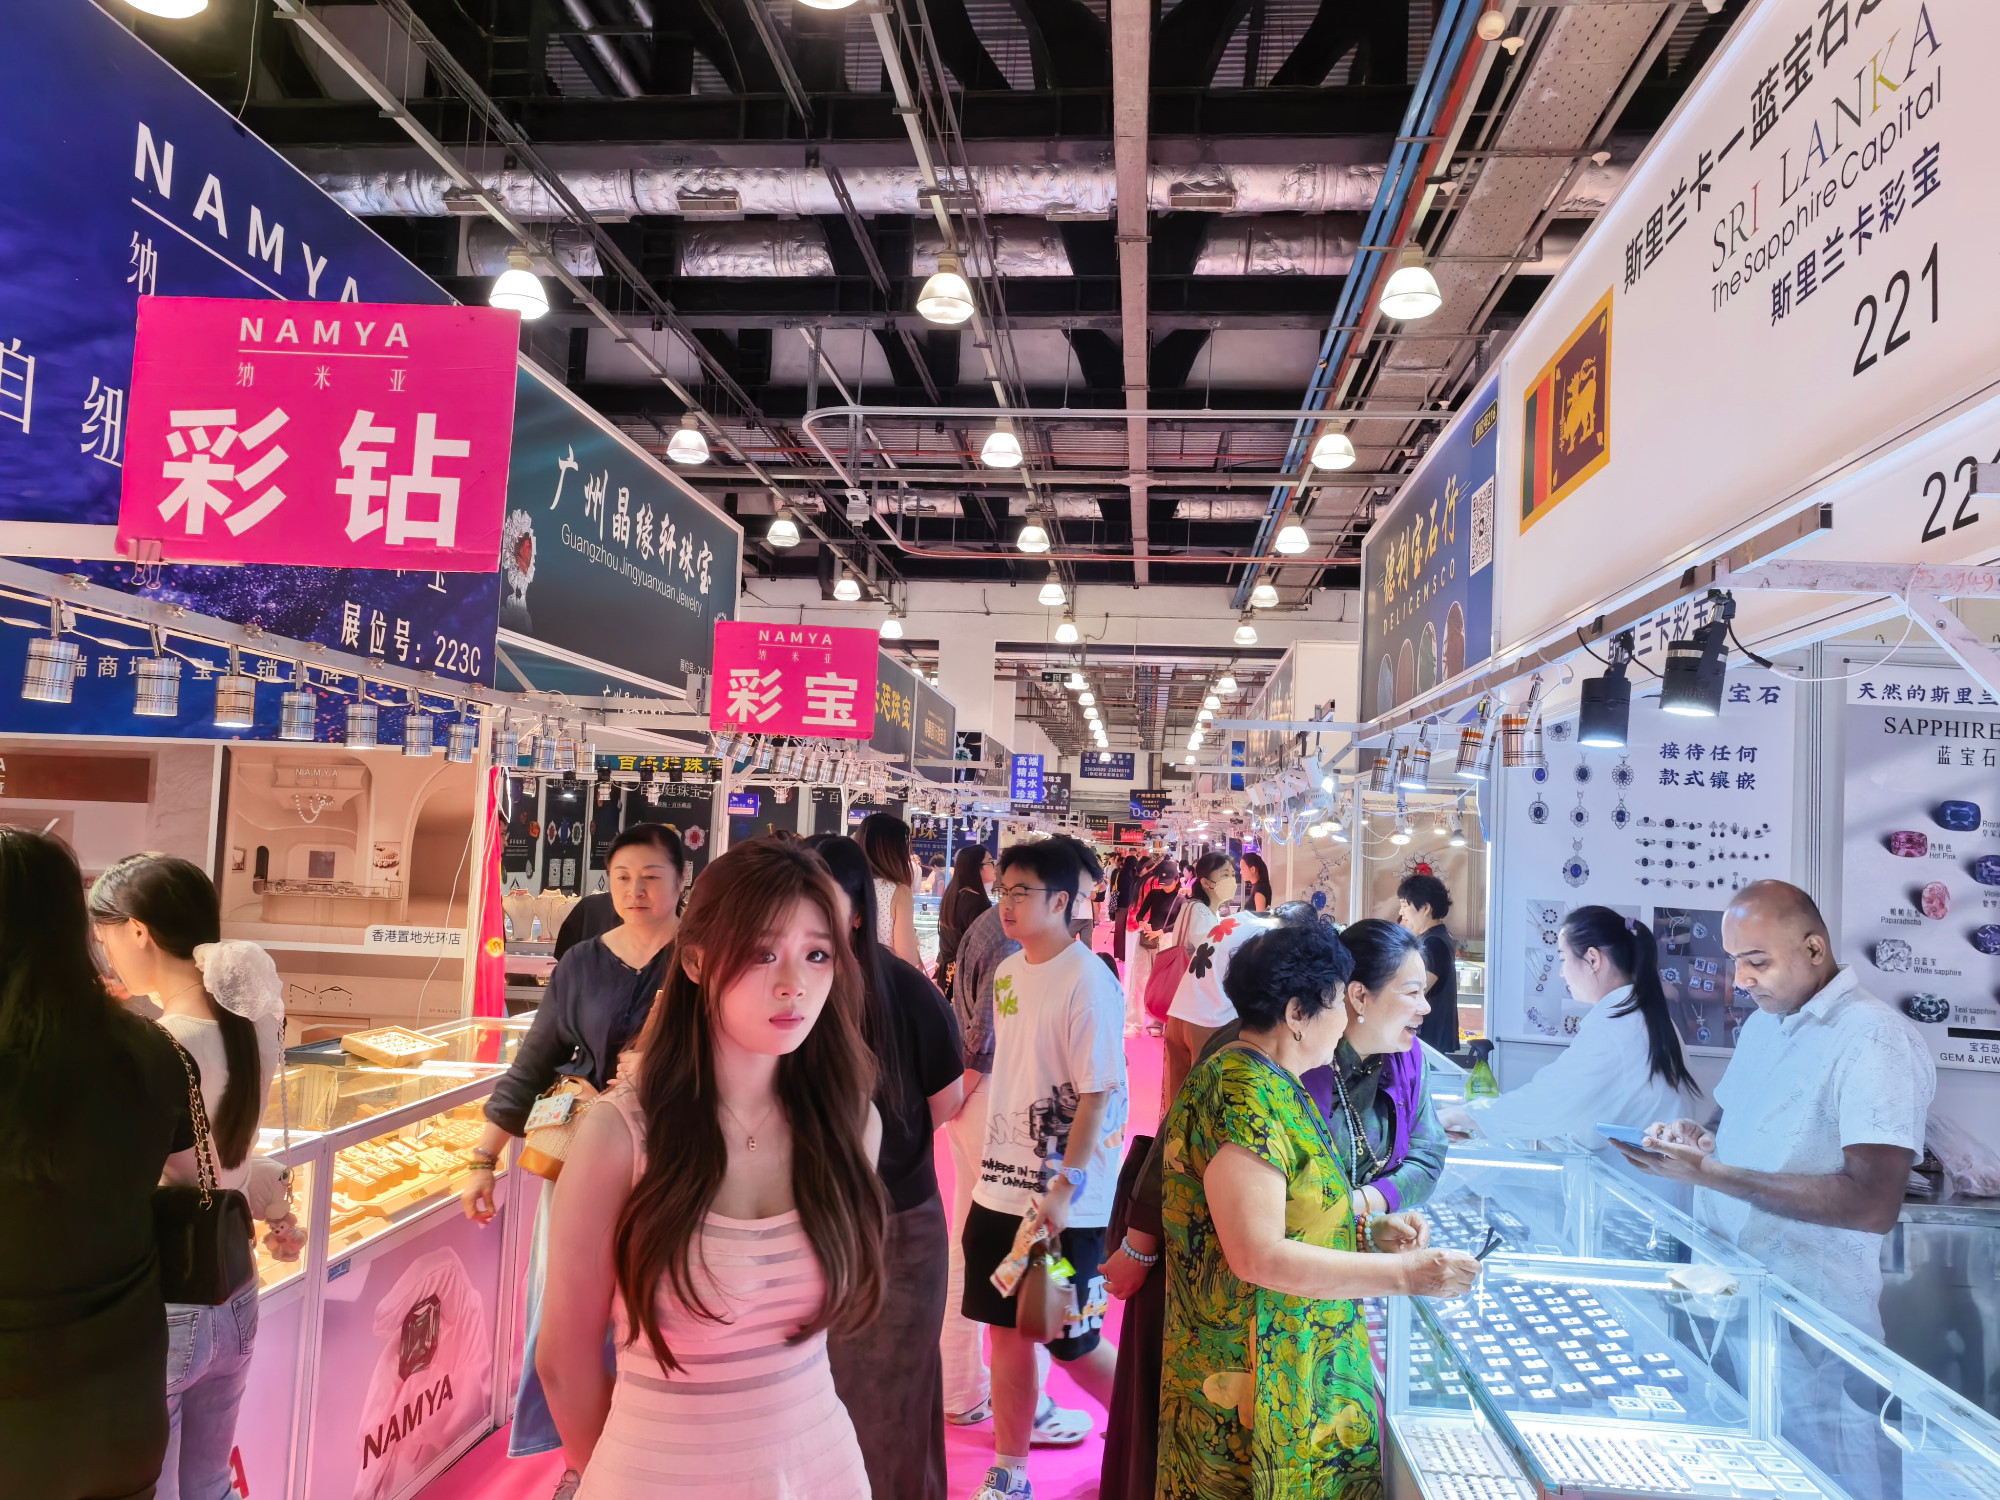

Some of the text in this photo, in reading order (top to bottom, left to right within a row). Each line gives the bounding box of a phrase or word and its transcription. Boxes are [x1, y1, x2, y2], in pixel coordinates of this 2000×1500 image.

[1712, 2, 1942, 273] SRI LANKA
[1771, 142, 1941, 327] 斯里兰卡彩宝
[1853, 242, 1938, 377] 221
[239, 317, 409, 347] NAMYA
[236, 362, 407, 392] 纳米亚
[157, 407, 470, 547] 彩钻
[1922, 449, 2000, 544] 22
[561, 523, 703, 617] Guangzhou Jingyuanxuan Jewelry
[759, 630, 832, 645] NAMYA
[727, 669, 858, 727] 彩宝
[1857, 682, 1999, 706] 天然的斯里兰
[1884, 717, 2000, 740] SAPPHIRE
[1017, 756, 1039, 767] 高端
[1659, 742, 1758, 764] 接待任何
[1937, 745, 1997, 768] 蓝宝石
[1016, 767, 1038, 778] 精品
[1016, 778, 1038, 789] 海水
[1658, 768, 1756, 790] 款式镶嵌
[1015, 789, 1038, 800] 珍珠
[372, 928, 461, 945] 香港置地光环店
[1913, 966, 1962, 976] White sapphire
[1954, 1005, 1997, 1015] Teal sapphire
[1940, 1053, 1965, 1062] GEM
[1017, 1166, 1028, 1177] IN
[362, 1374, 454, 1470] NAMYA
